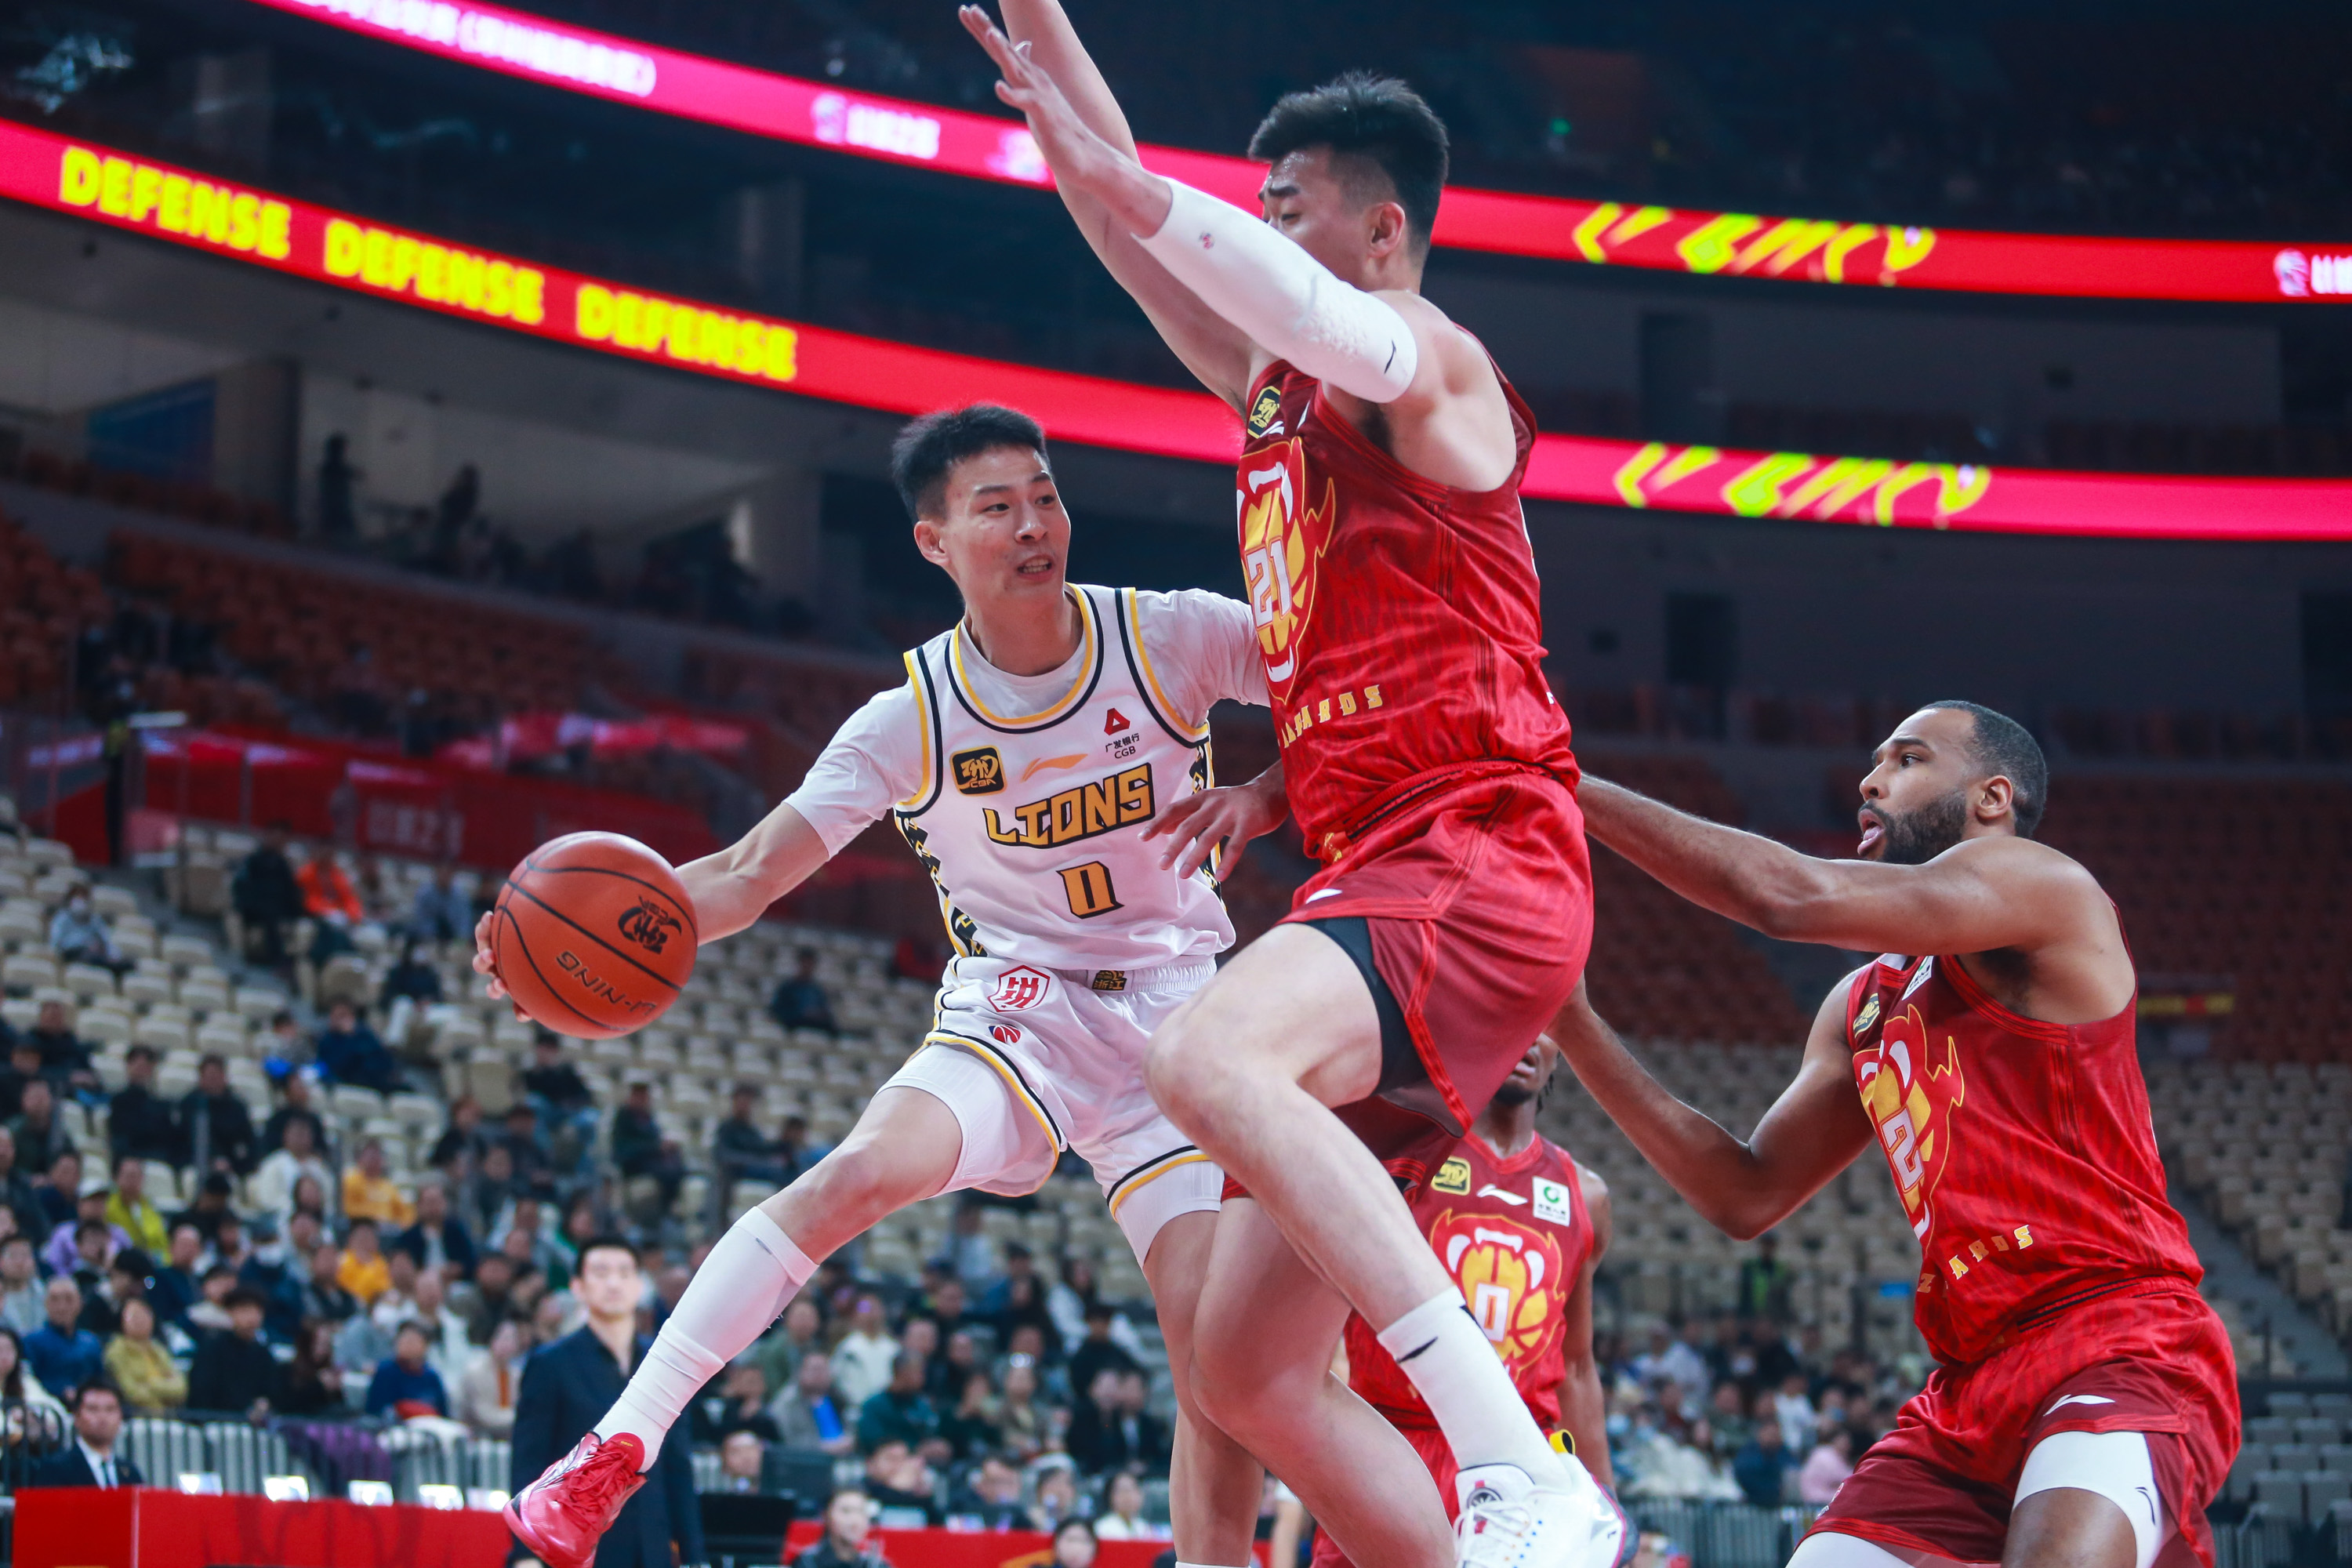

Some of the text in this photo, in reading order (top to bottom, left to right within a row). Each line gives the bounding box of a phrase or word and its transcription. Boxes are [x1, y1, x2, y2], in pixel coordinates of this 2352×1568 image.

[63, 149, 795, 379] DEFENSE DEFENSE DEFENSE
[1245, 536, 1292, 631] 21
[1105, 733, 1140, 753] 广发银行
[1114, 746, 1136, 759] CGB
[970, 779, 996, 788] CBA
[983, 763, 1156, 849] LIONS
[1056, 860, 1125, 919] 0
[1882, 1106, 1925, 1192] 2
[1474, 1283, 1511, 1342] 0
